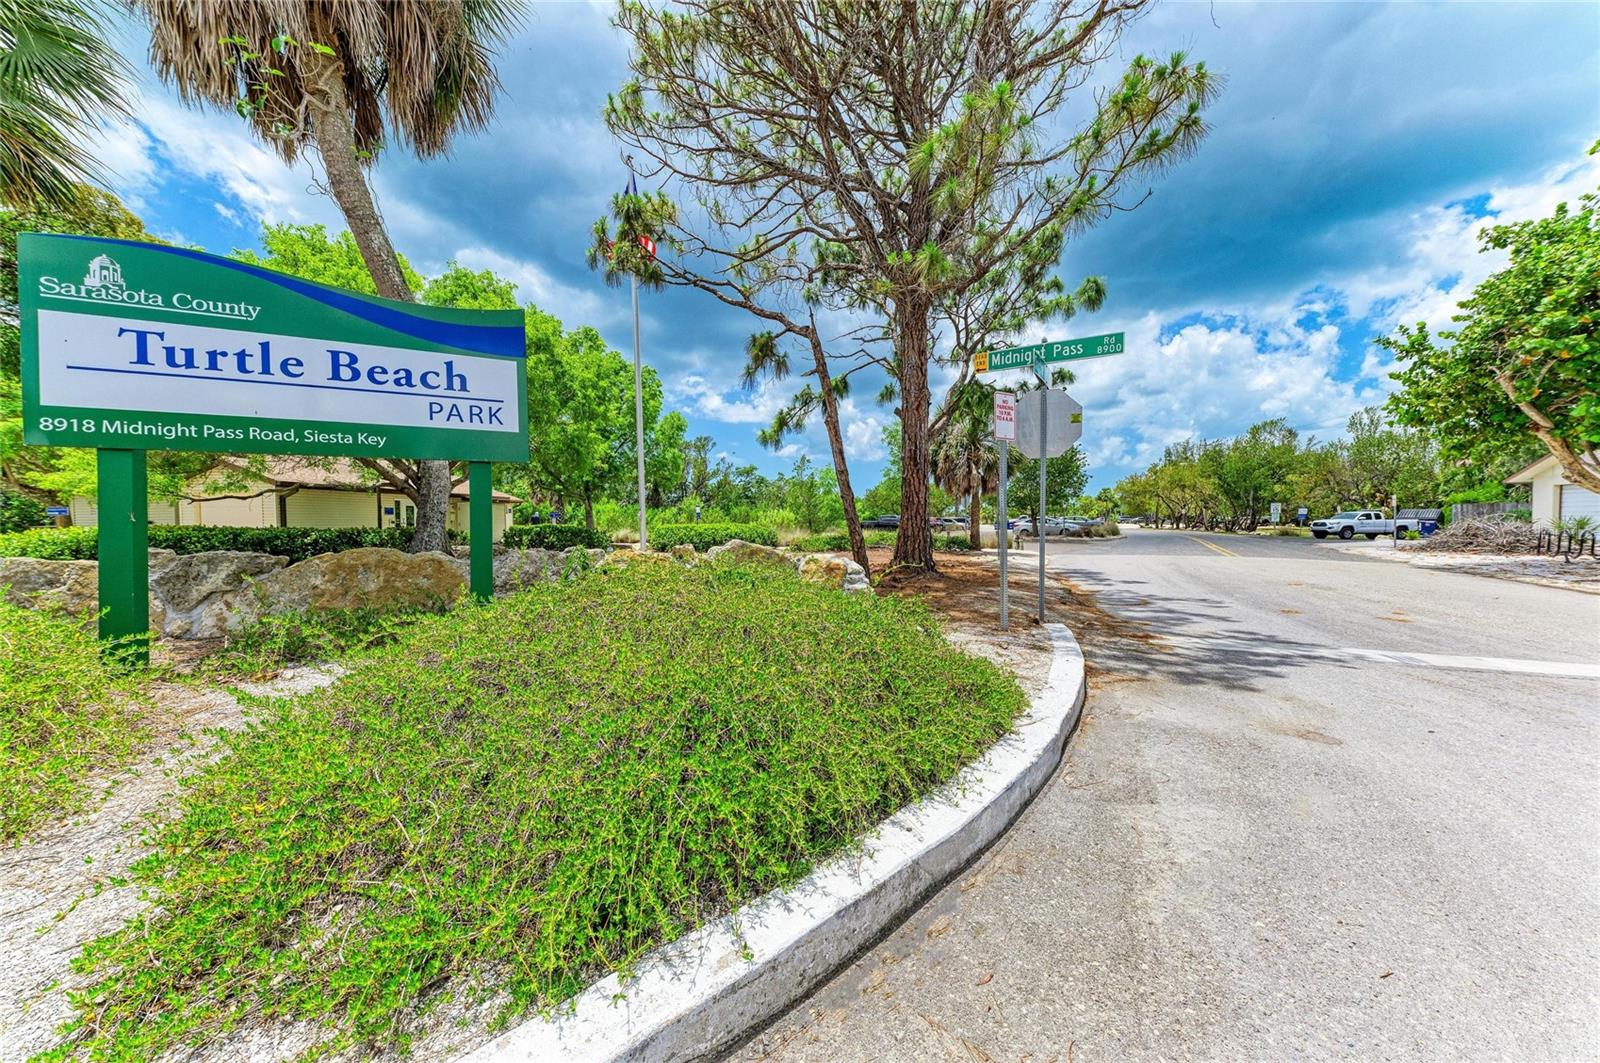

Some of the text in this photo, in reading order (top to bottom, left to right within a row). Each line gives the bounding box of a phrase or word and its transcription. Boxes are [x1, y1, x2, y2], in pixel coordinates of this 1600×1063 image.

[39, 276, 262, 321] Sarasota County
[1097, 343, 1122, 354] 8900
[1103, 336, 1116, 345] Rd
[117, 327, 471, 393] Turtle Beach
[991, 344, 1084, 367] Midnight Pass
[428, 401, 504, 426] PARK
[39, 417, 387, 448] 8918 Midnight Pass Road, Siesta Key
